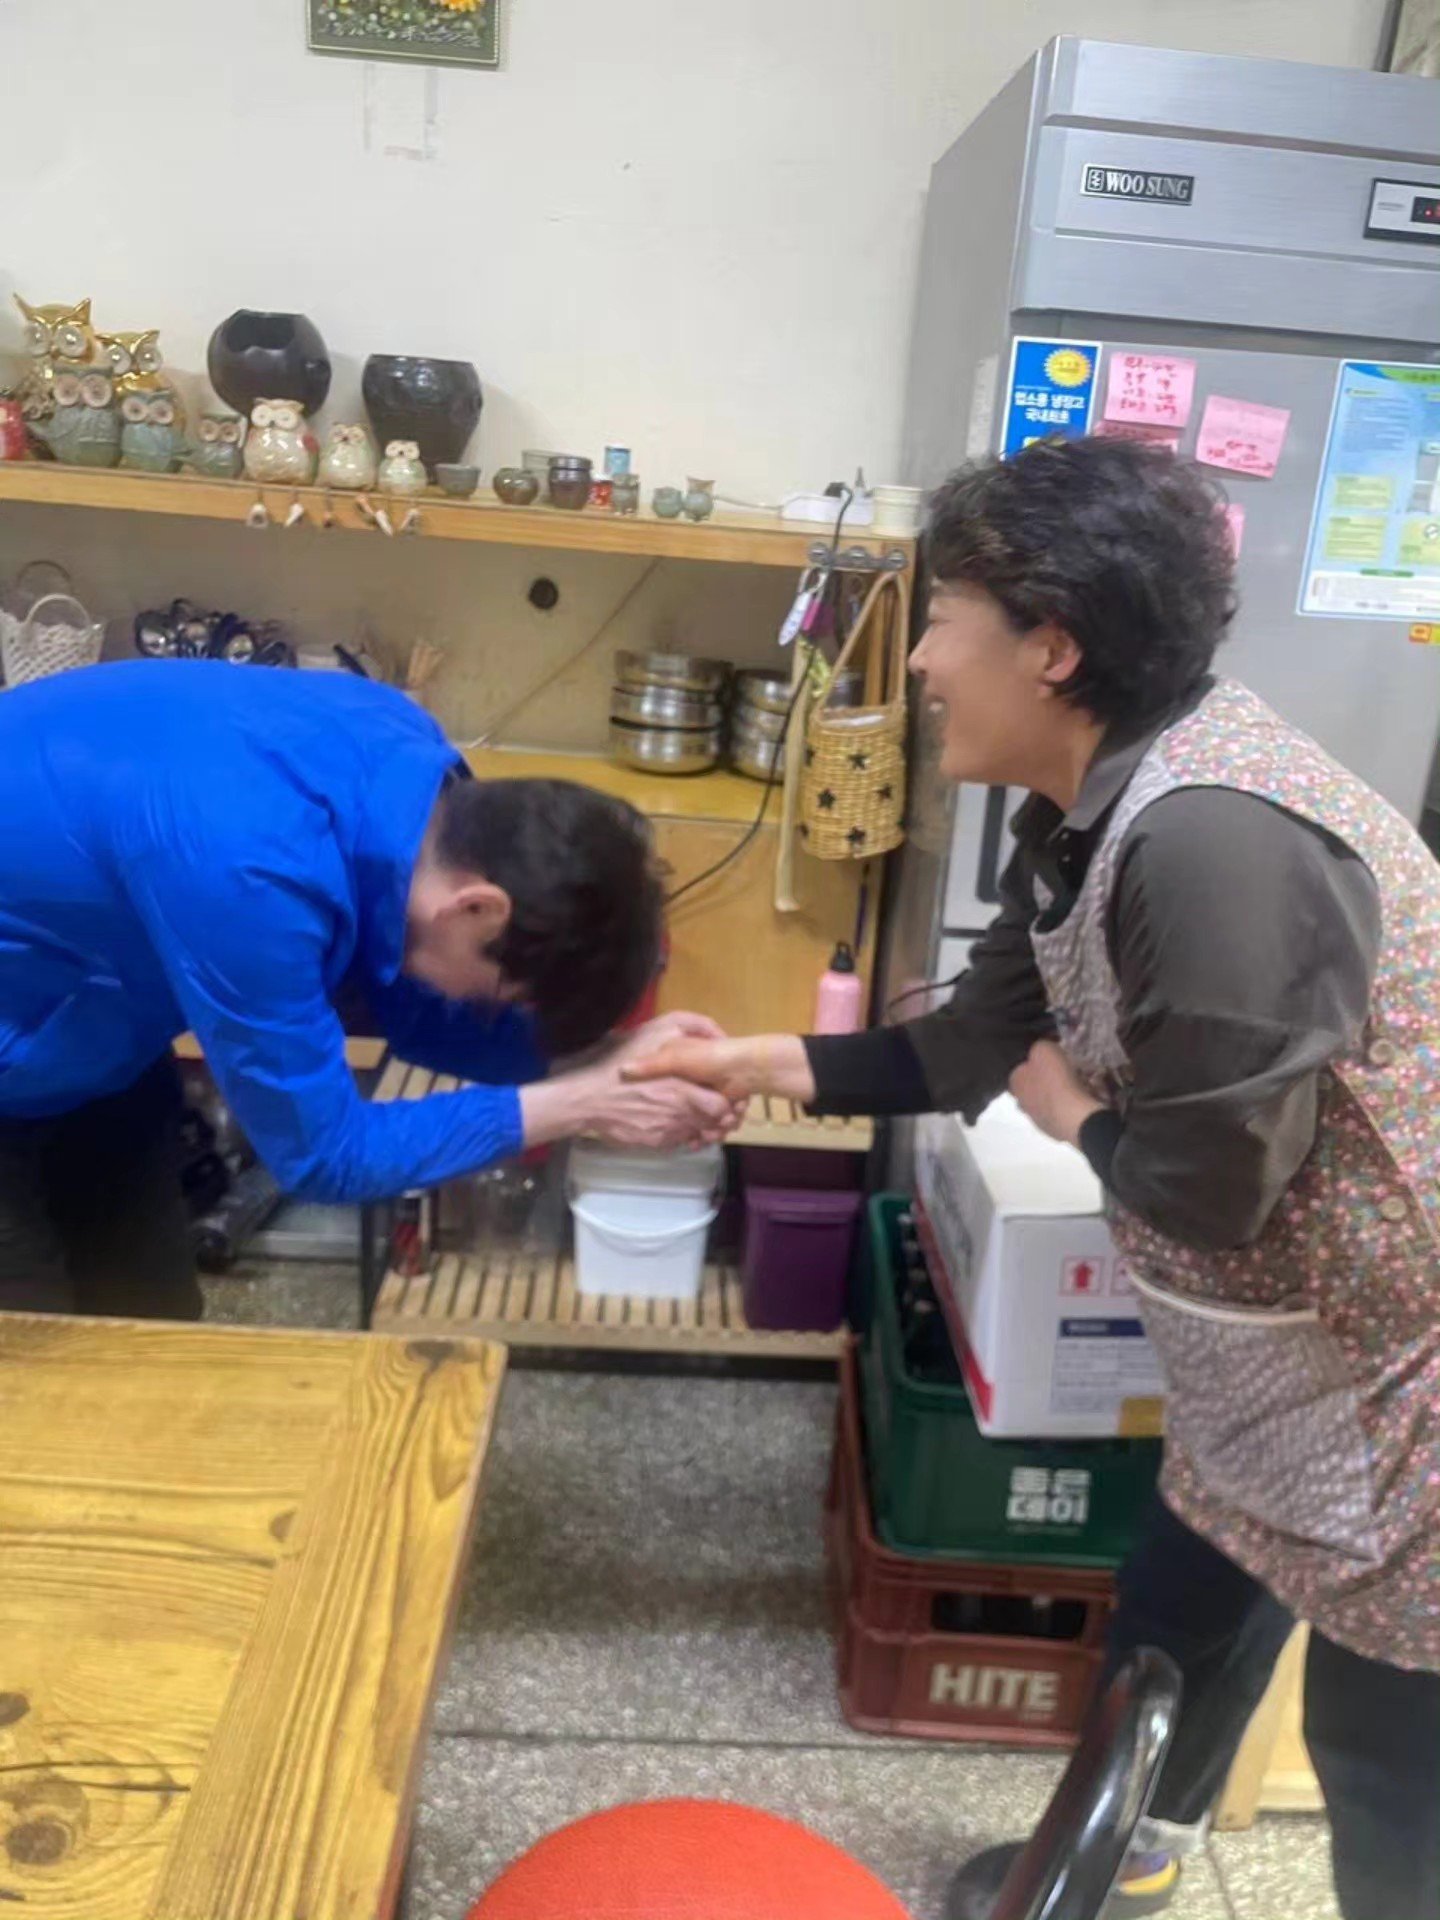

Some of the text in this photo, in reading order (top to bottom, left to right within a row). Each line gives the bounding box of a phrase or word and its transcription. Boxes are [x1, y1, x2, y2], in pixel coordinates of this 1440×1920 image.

[1106, 171, 1190, 199] WOO SUNG
[930, 1663, 1058, 1711] HITE
